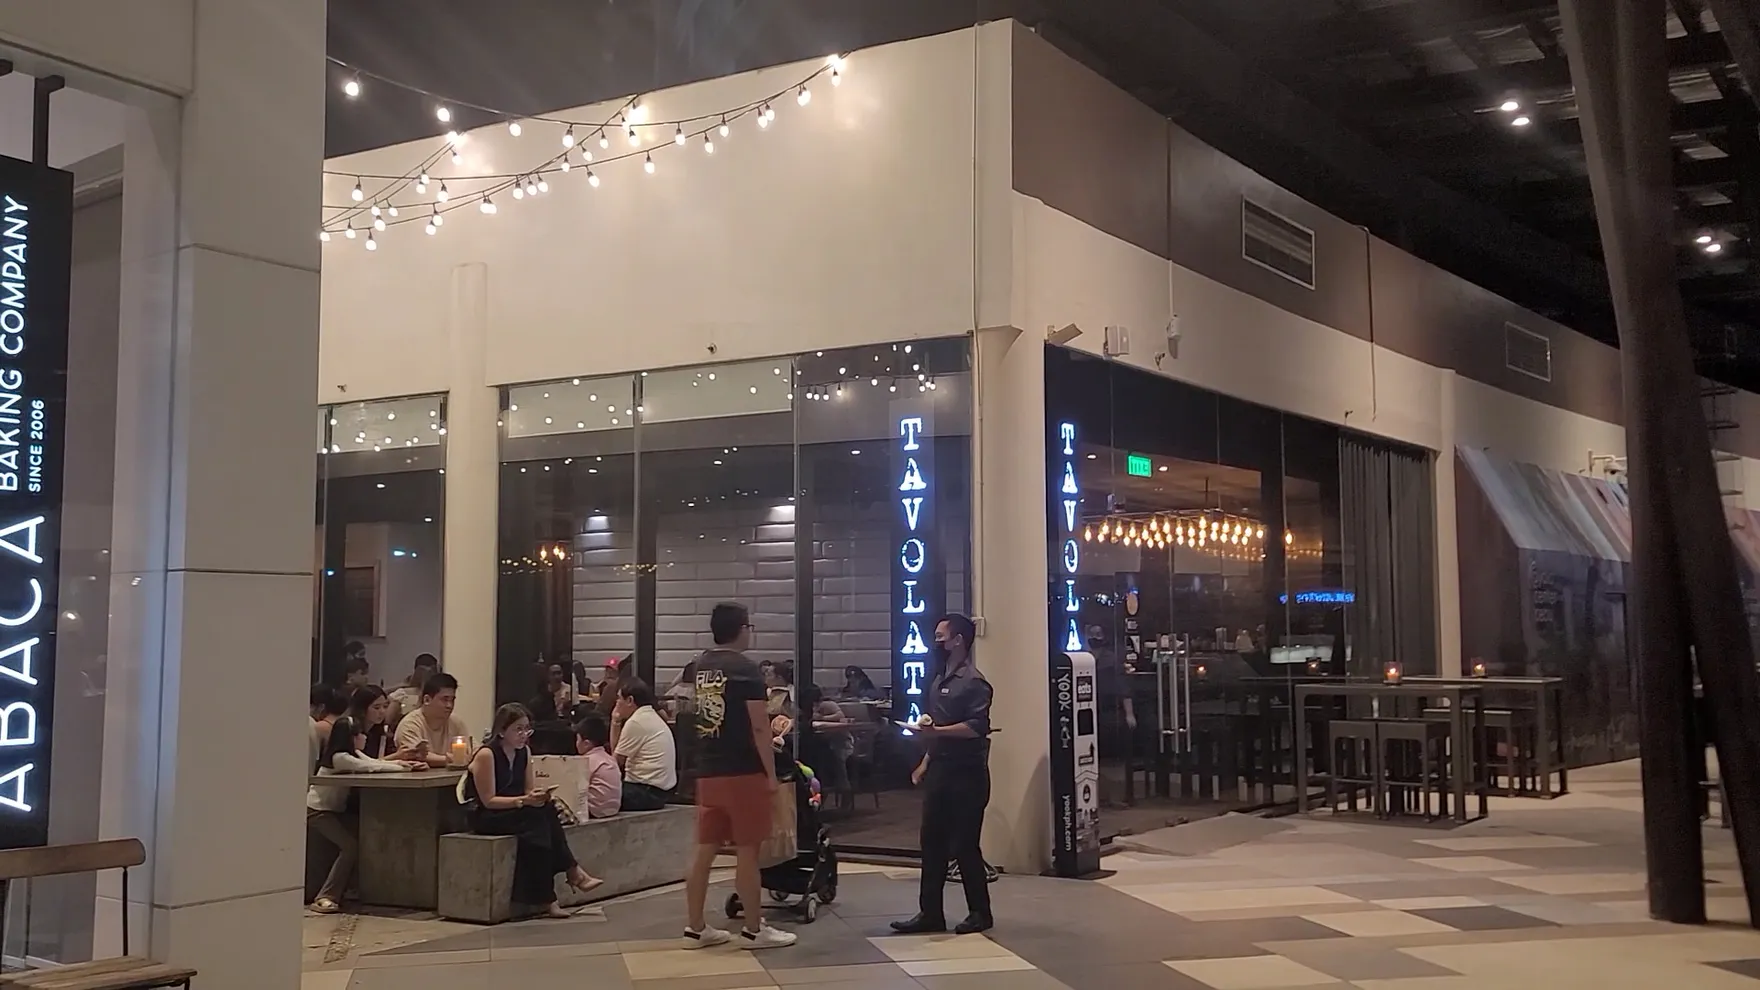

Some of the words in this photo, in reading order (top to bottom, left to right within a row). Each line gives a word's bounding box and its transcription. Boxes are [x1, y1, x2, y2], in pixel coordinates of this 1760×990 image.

[0, 194, 29, 355] COMPANY
[0, 368, 23, 492] BAKING
[31, 399, 45, 440] 2006
[29, 445, 43, 493] SINCE
[899, 417, 929, 735] TAVOLATA
[0, 515, 45, 813] ABACA
[696, 669, 727, 688] FILA
[1061, 795, 1072, 852] yookph.com
